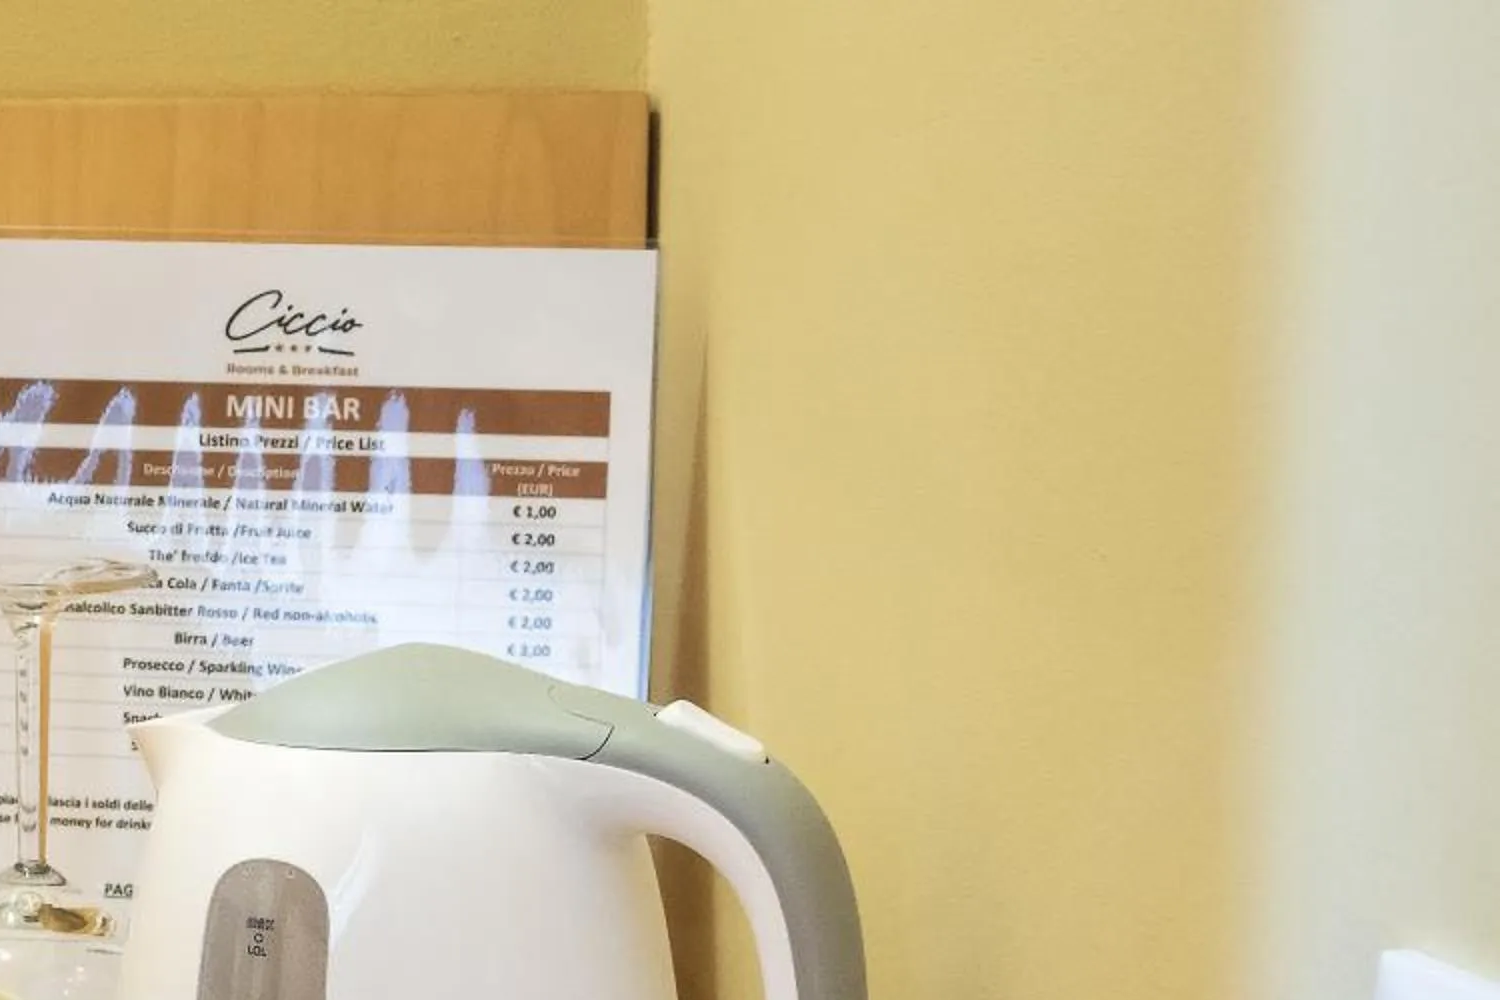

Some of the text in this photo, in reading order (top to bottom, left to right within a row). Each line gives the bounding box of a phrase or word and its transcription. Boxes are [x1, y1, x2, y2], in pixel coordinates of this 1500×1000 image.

[225, 289, 363, 341] Ciccio
[292, 363, 359, 377] Breakfast
[226, 395, 361, 421] MINI BAR
[199, 433, 250, 449] Listino
[255, 435, 299, 450] Prezzi
[315, 436, 354, 451] Price
[358, 437, 386, 451] List
[143, 463, 215, 477] Descne
[227, 465, 299, 480] Dption
[48, 492, 91, 507] Acqua
[94, 493, 155, 507] Naturale
[158, 494, 222, 509] Minerale
[235, 498, 288, 511] Natural
[291, 498, 346, 512] Mineral
[350, 500, 393, 514] Water
[526, 506, 557, 519] 1,00
[126, 520, 167, 533] Succo
[170, 522, 183, 534] di
[524, 533, 555, 547] 2,00
[523, 561, 554, 575] 2,00
[167, 577, 197, 589] Cola
[211, 578, 250, 592] Fanta
[63, 601, 126, 615] nalcolico
[129, 603, 193, 617] Sanbitter
[197, 605, 238, 619] Rosso
[252, 607, 279, 620] Red
[173, 631, 208, 645] Birra
[222, 634, 255, 647] Beer
[122, 657, 185, 672] Prosecco
[198, 659, 263, 677] Sparkling
[122, 685, 155, 698] Vino
[158, 685, 205, 700] Bianco
[219, 687, 257, 701] Whit
[91, 797, 121, 810] soldi
[50, 816, 92, 830] money
[95, 815, 113, 828] for
[103, 883, 134, 898] PAG
